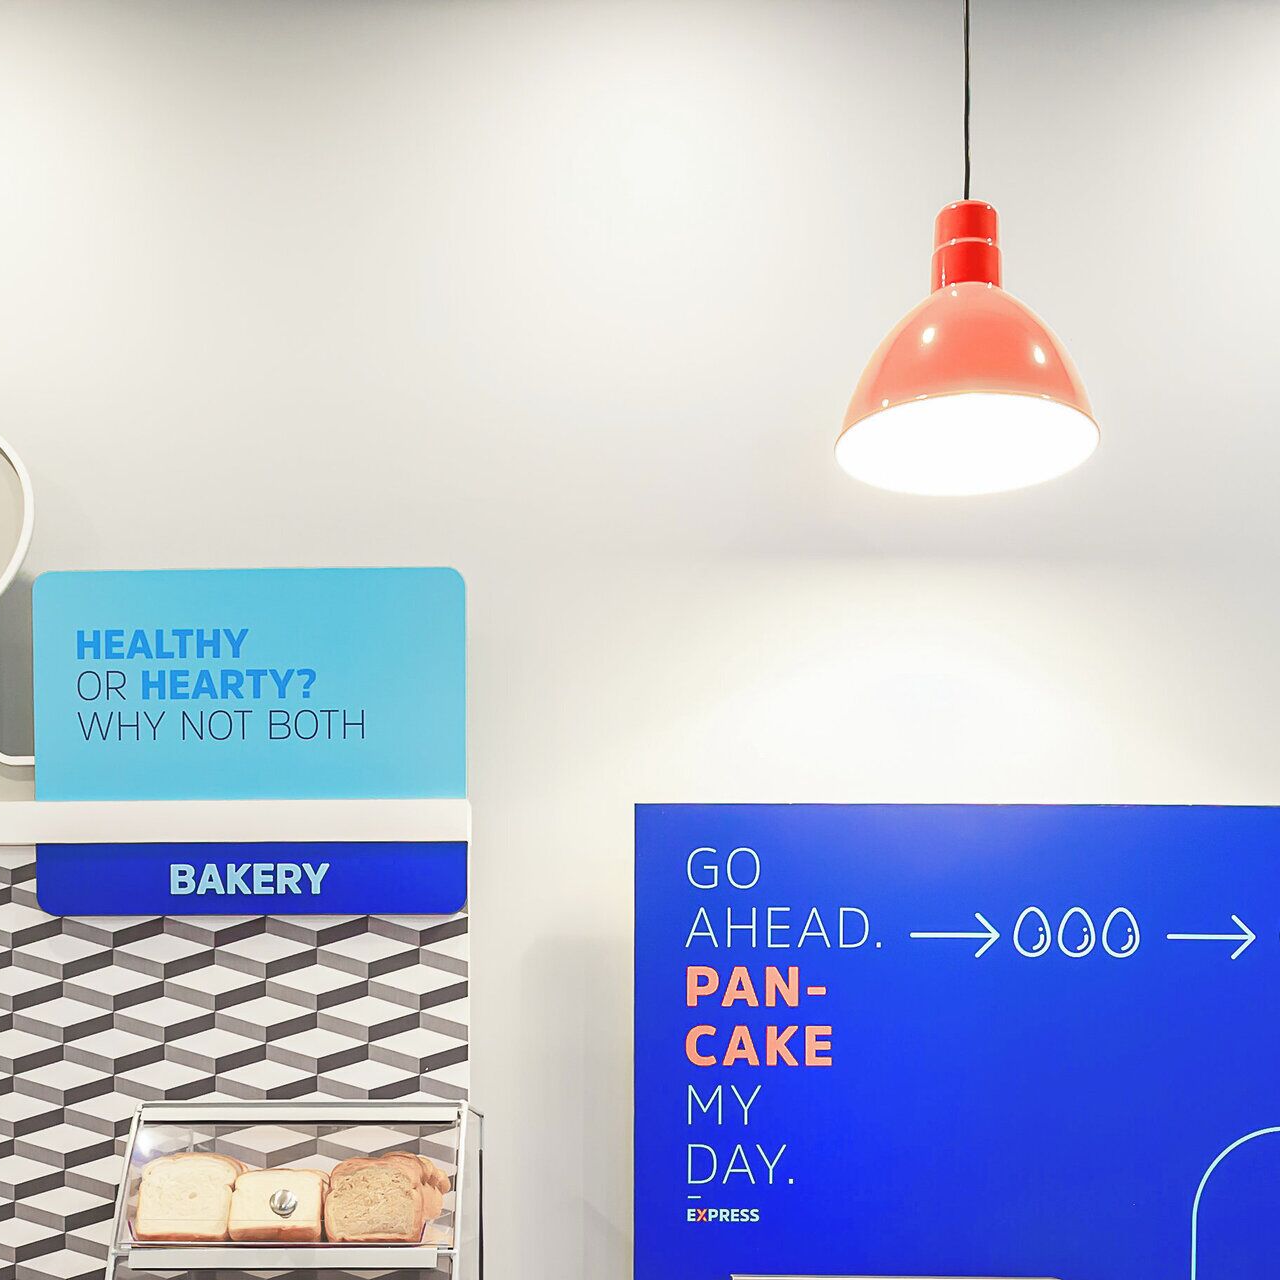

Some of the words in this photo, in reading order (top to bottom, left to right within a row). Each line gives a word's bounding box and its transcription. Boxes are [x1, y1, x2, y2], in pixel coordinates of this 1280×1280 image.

[76, 628, 249, 660] HEALTHY
[77, 670, 127, 701] OR
[141, 668, 317, 700] HEARTY?
[77, 710, 166, 741] WHY
[181, 709, 253, 741] NOT
[269, 709, 366, 740] BOTH
[170, 862, 330, 895] BAKERY
[686, 847, 761, 890] GO
[685, 906, 882, 949] AHEAD.
[686, 966, 827, 1007] PAN-
[685, 1025, 833, 1067] CAKE
[687, 1084, 762, 1126] MY
[687, 1143, 795, 1185] DAY.
[687, 1208, 760, 1222] EXPRESS
